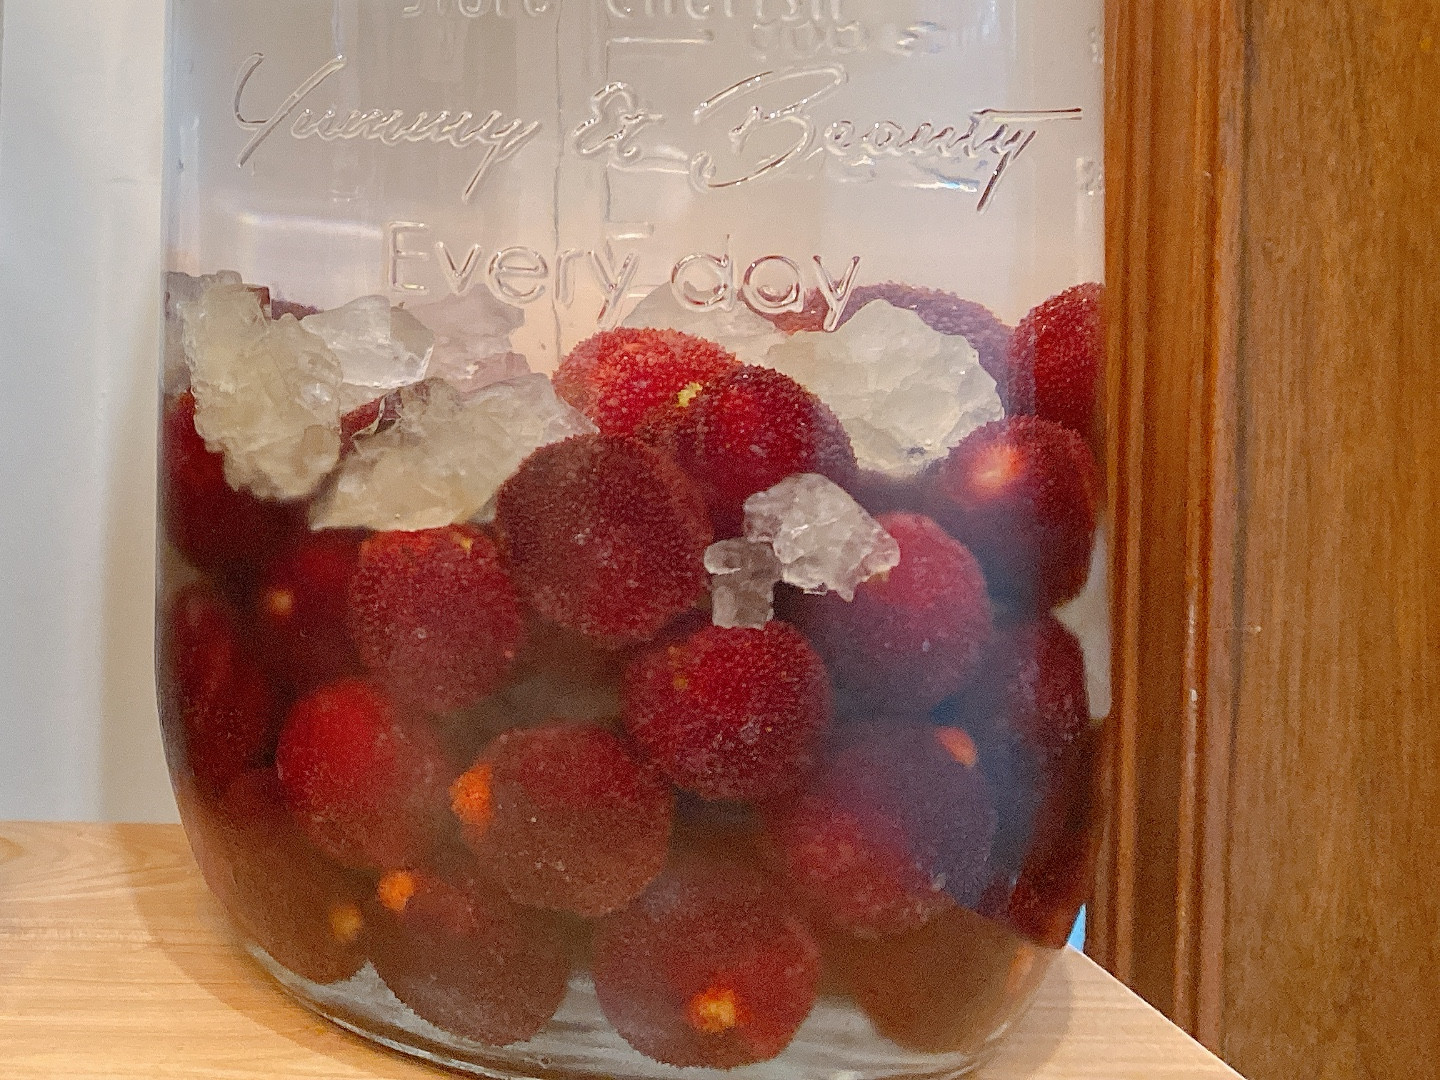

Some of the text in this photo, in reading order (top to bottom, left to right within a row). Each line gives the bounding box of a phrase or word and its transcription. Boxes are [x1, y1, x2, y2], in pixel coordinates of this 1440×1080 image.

[233, 52, 1083, 213] Yummy & Beauty
[387, 221, 861, 332] Every day
